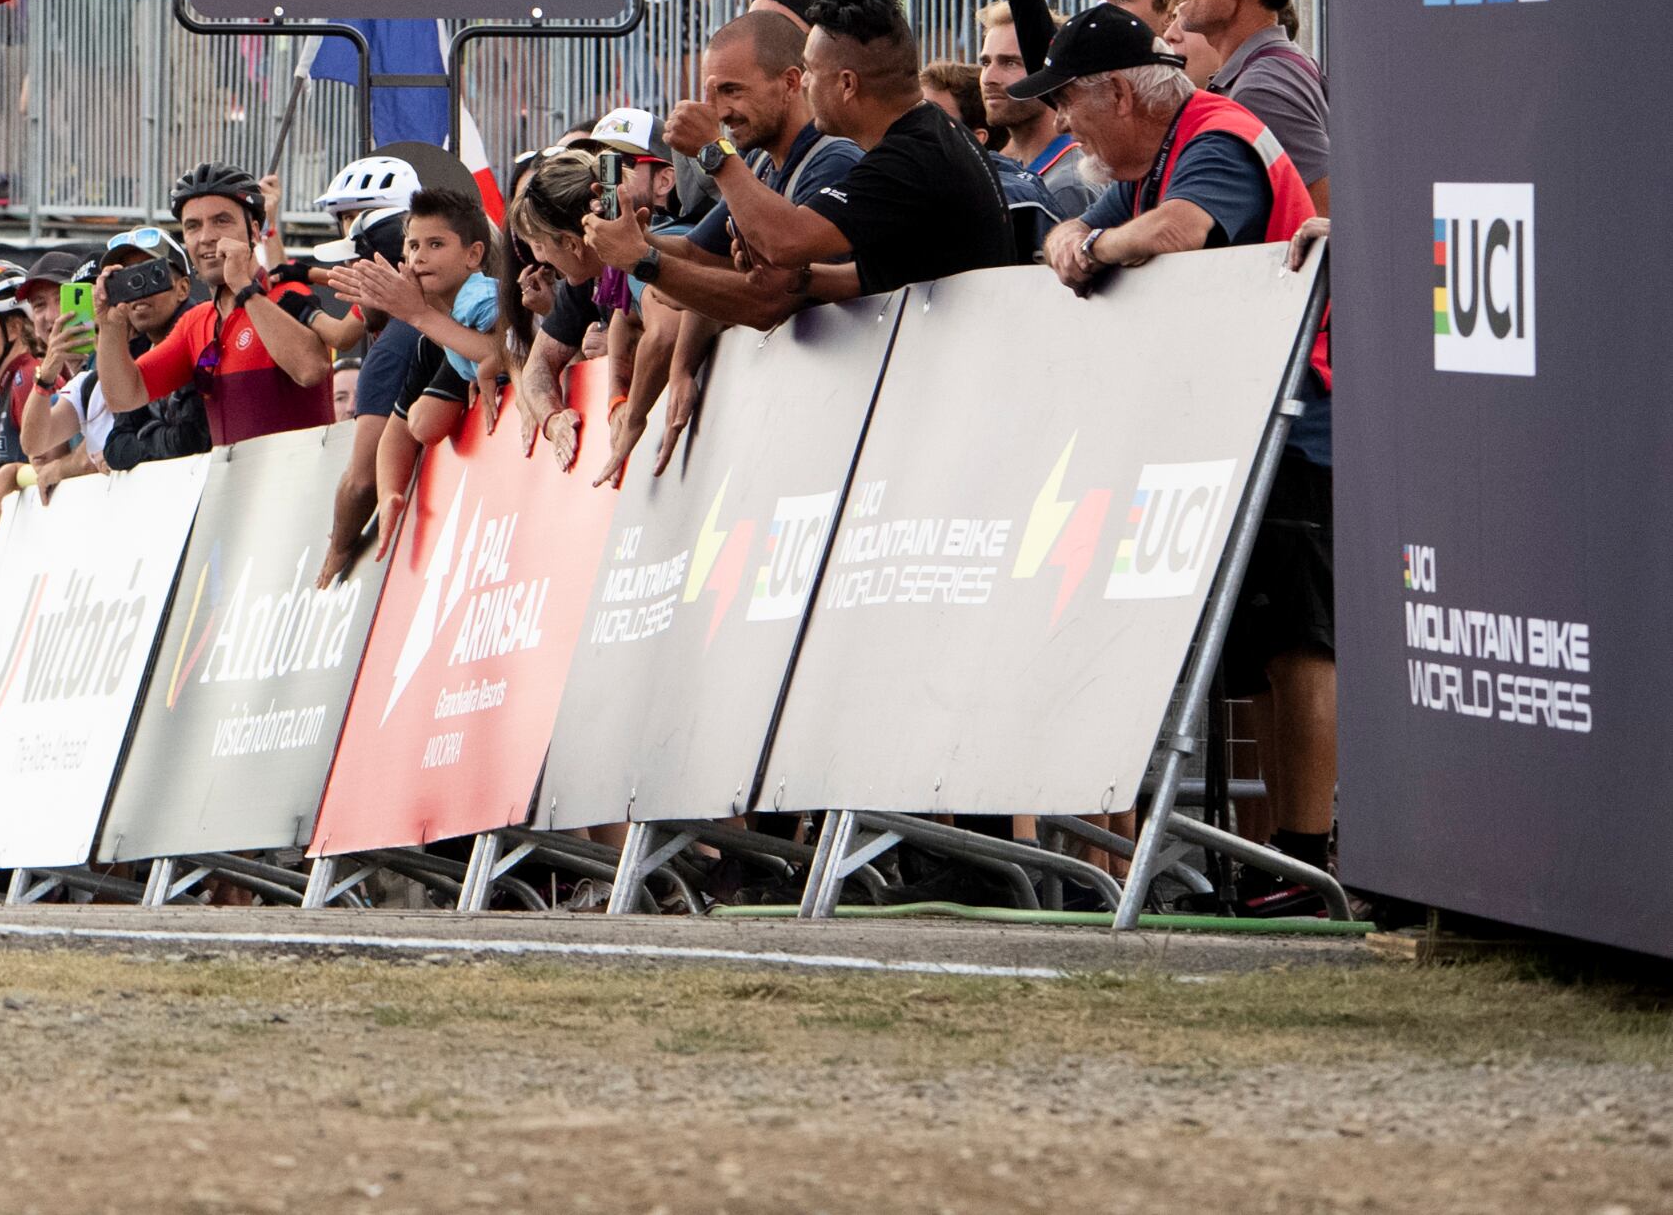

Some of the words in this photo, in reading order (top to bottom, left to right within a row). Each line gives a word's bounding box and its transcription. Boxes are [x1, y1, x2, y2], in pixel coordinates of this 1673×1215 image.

[1450, 217, 1526, 340] UCI
[469, 512, 518, 590] PAL
[838, 518, 944, 564] MOUNTAIN
[941, 518, 1013, 557] BIKE
[1135, 486, 1223, 575] UCI
[826, 565, 897, 610] WORLD
[893, 565, 998, 604] SERIES
[1408, 544, 1436, 592] UCI
[199, 545, 362, 684] Andorra
[447, 576, 551, 667] ARINSAL
[590, 606, 648, 644] WORLD
[1405, 600, 1523, 664] MOUNTAIN
[1526, 616, 1590, 672] BIKE
[211, 697, 327, 758] visitandorra.com
[1407, 658, 1494, 719] WORLD
[1496, 673, 1593, 734] SERIES
[420, 730, 465, 770] ANDORRA
